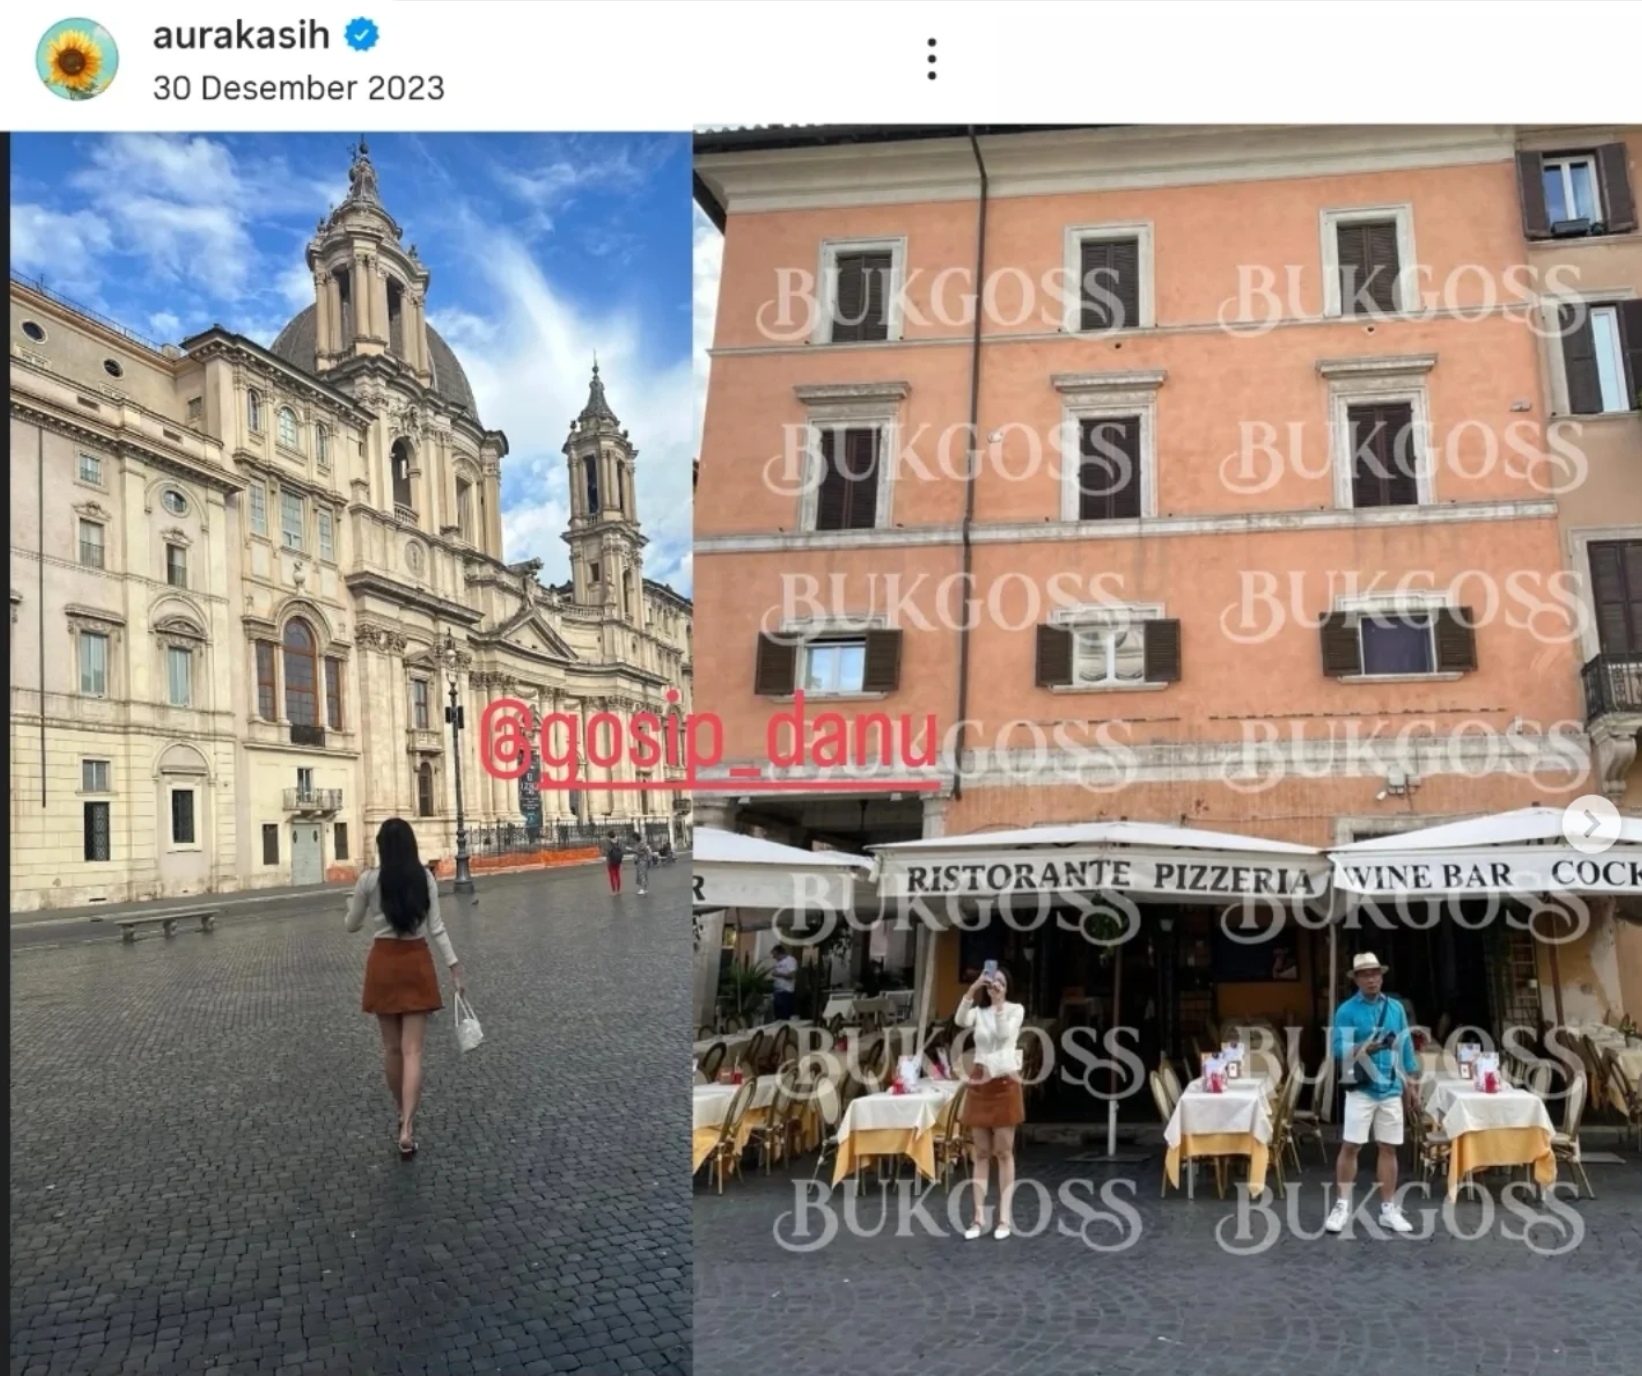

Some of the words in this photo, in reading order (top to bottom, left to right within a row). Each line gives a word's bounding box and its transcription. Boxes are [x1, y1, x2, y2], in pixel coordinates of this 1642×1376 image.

[906, 859, 1132, 894] RISTORANTE
[1154, 862, 1316, 896] PIZZERIA
[1345, 864, 1432, 890] WINE
[1441, 862, 1515, 889] BAR
